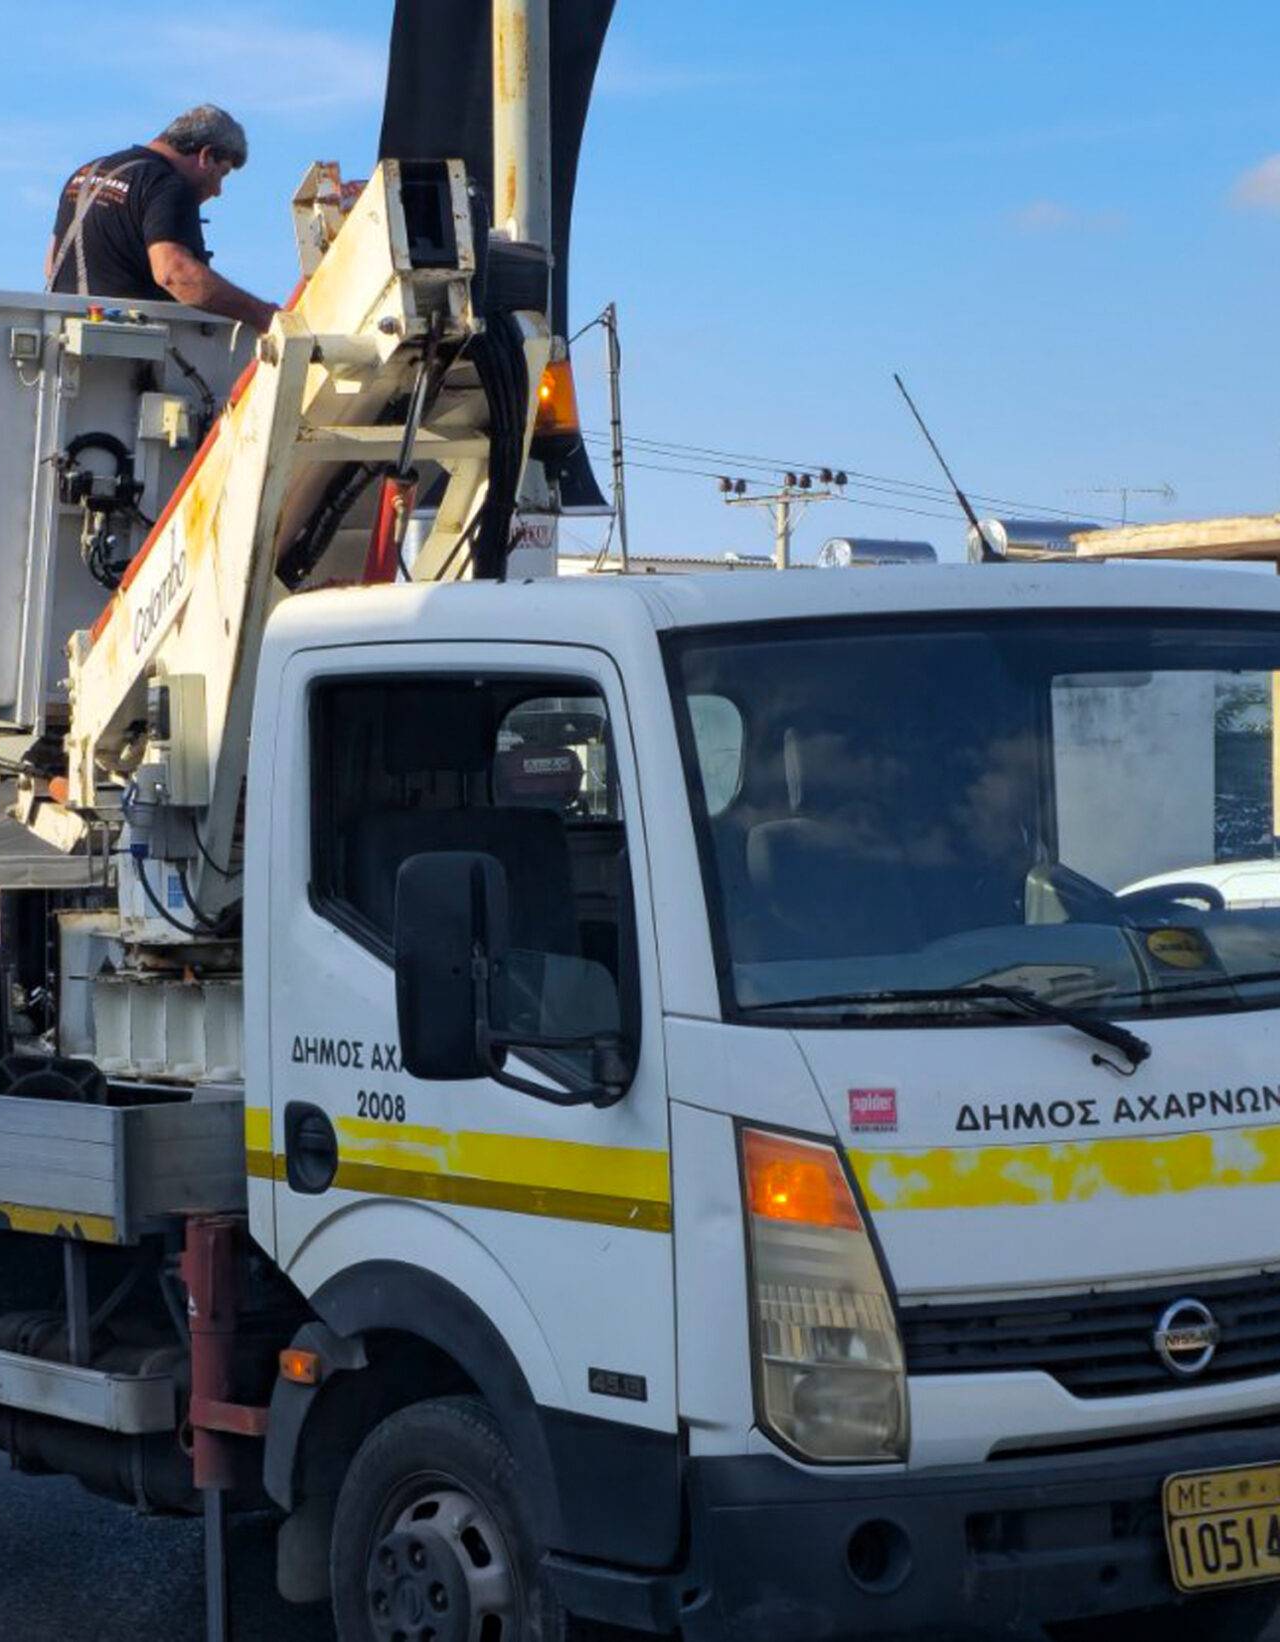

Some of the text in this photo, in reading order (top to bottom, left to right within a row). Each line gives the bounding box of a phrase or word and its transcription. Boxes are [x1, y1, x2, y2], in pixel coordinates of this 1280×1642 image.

[291, 1035, 364, 1069] ΔΗΜΟΣ
[357, 1090, 406, 1123] 2008
[955, 1100, 1100, 1132] ΔΗΜΟΣ
